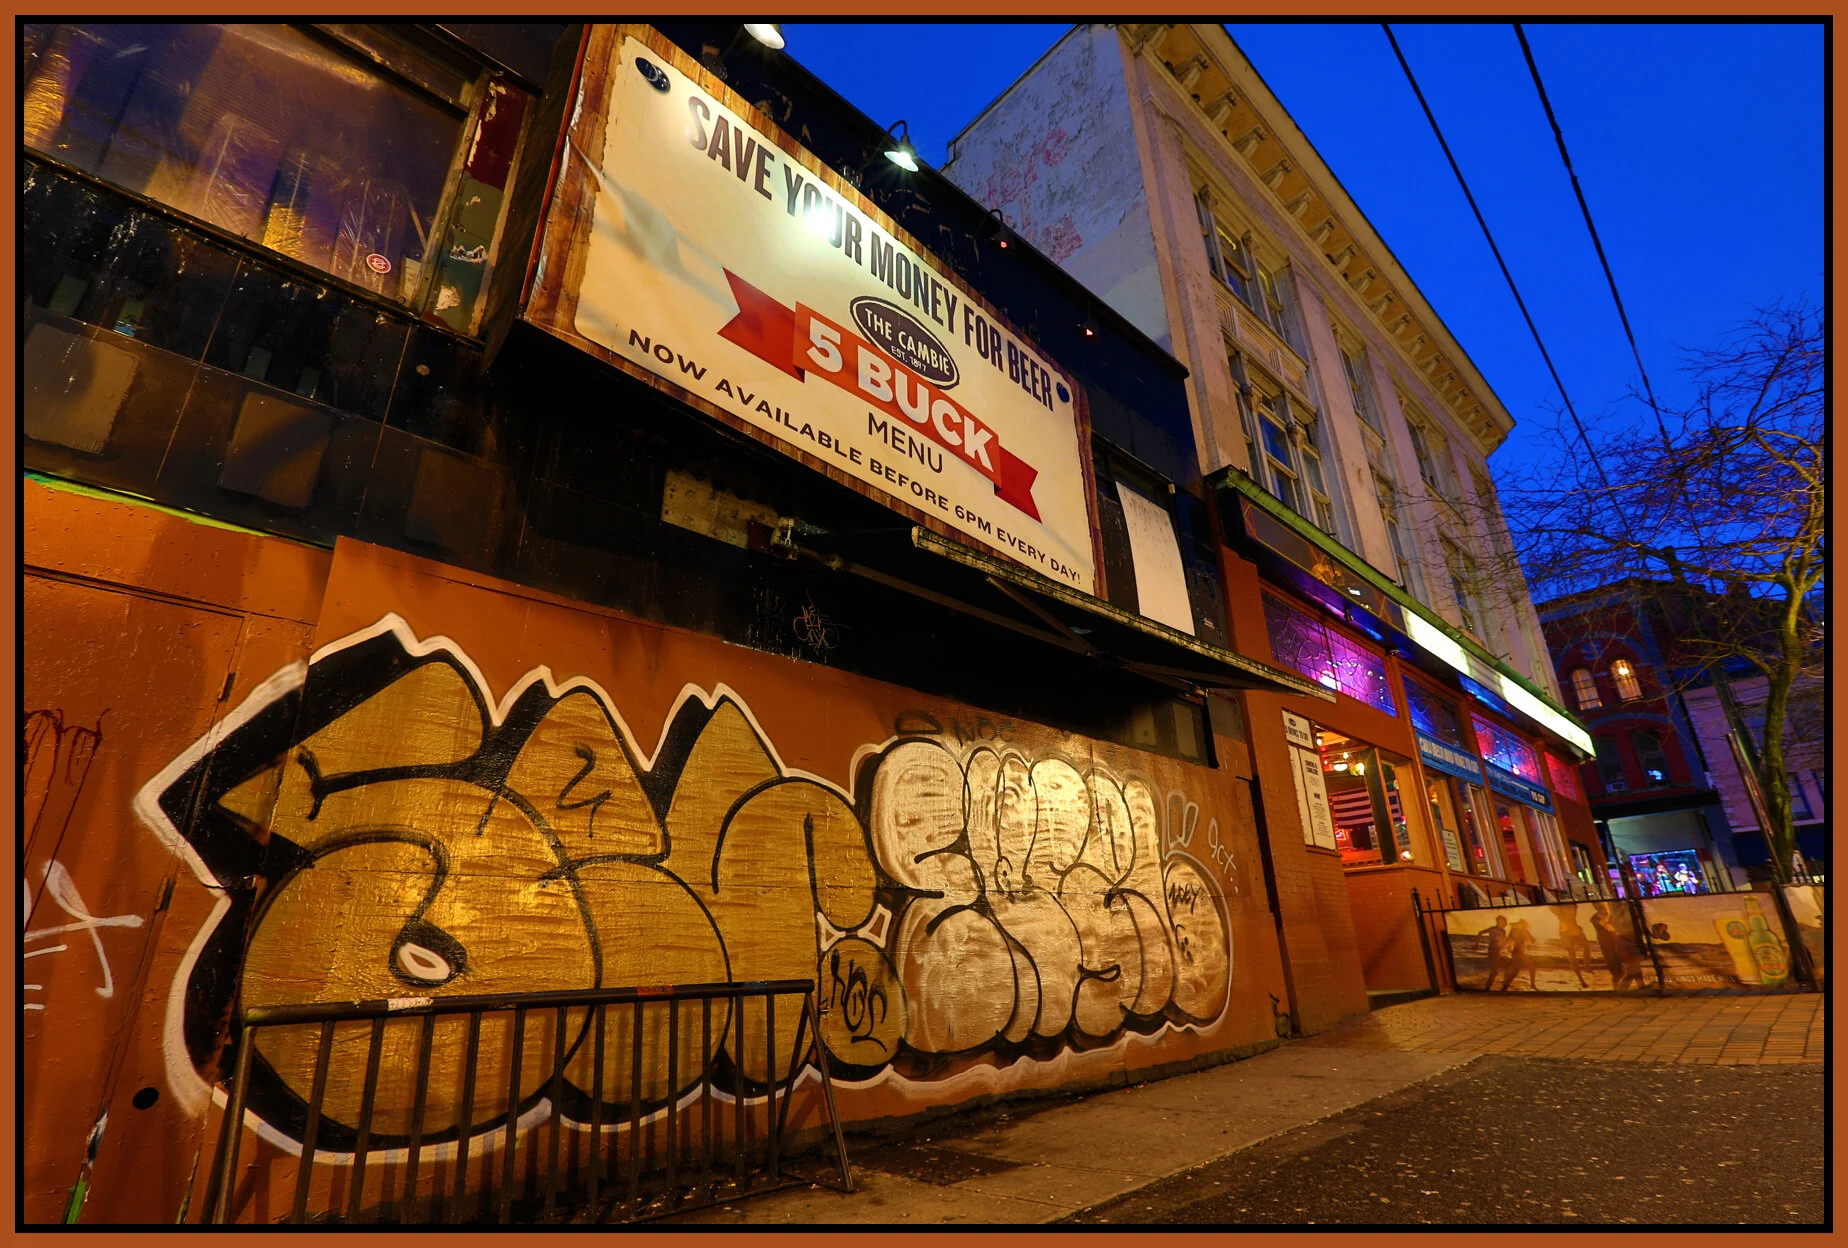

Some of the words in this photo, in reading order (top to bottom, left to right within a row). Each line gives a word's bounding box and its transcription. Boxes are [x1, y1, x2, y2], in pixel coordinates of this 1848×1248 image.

[686, 96, 775, 200] SAVE
[784, 163, 863, 266] YOUR
[871, 232, 957, 334] MONEY
[964, 304, 1003, 374] FOR
[1008, 346, 1055, 412] BEER
[807, 318, 844, 373] 5
[858, 345, 998, 473] BUCK
[865, 308, 892, 340] THE
[898, 330, 950, 376] CAMBIE
[891, 345, 908, 362] EST.
[628, 328, 706, 381] NOW
[714, 378, 862, 466] AVAILABLE
[870, 456, 949, 512] BEFORE
[955, 504, 992, 535] 6PM
[997, 526, 1046, 564] EVERY
[1050, 557, 1081, 585] DAY!
[868, 412, 944, 474] MENU
